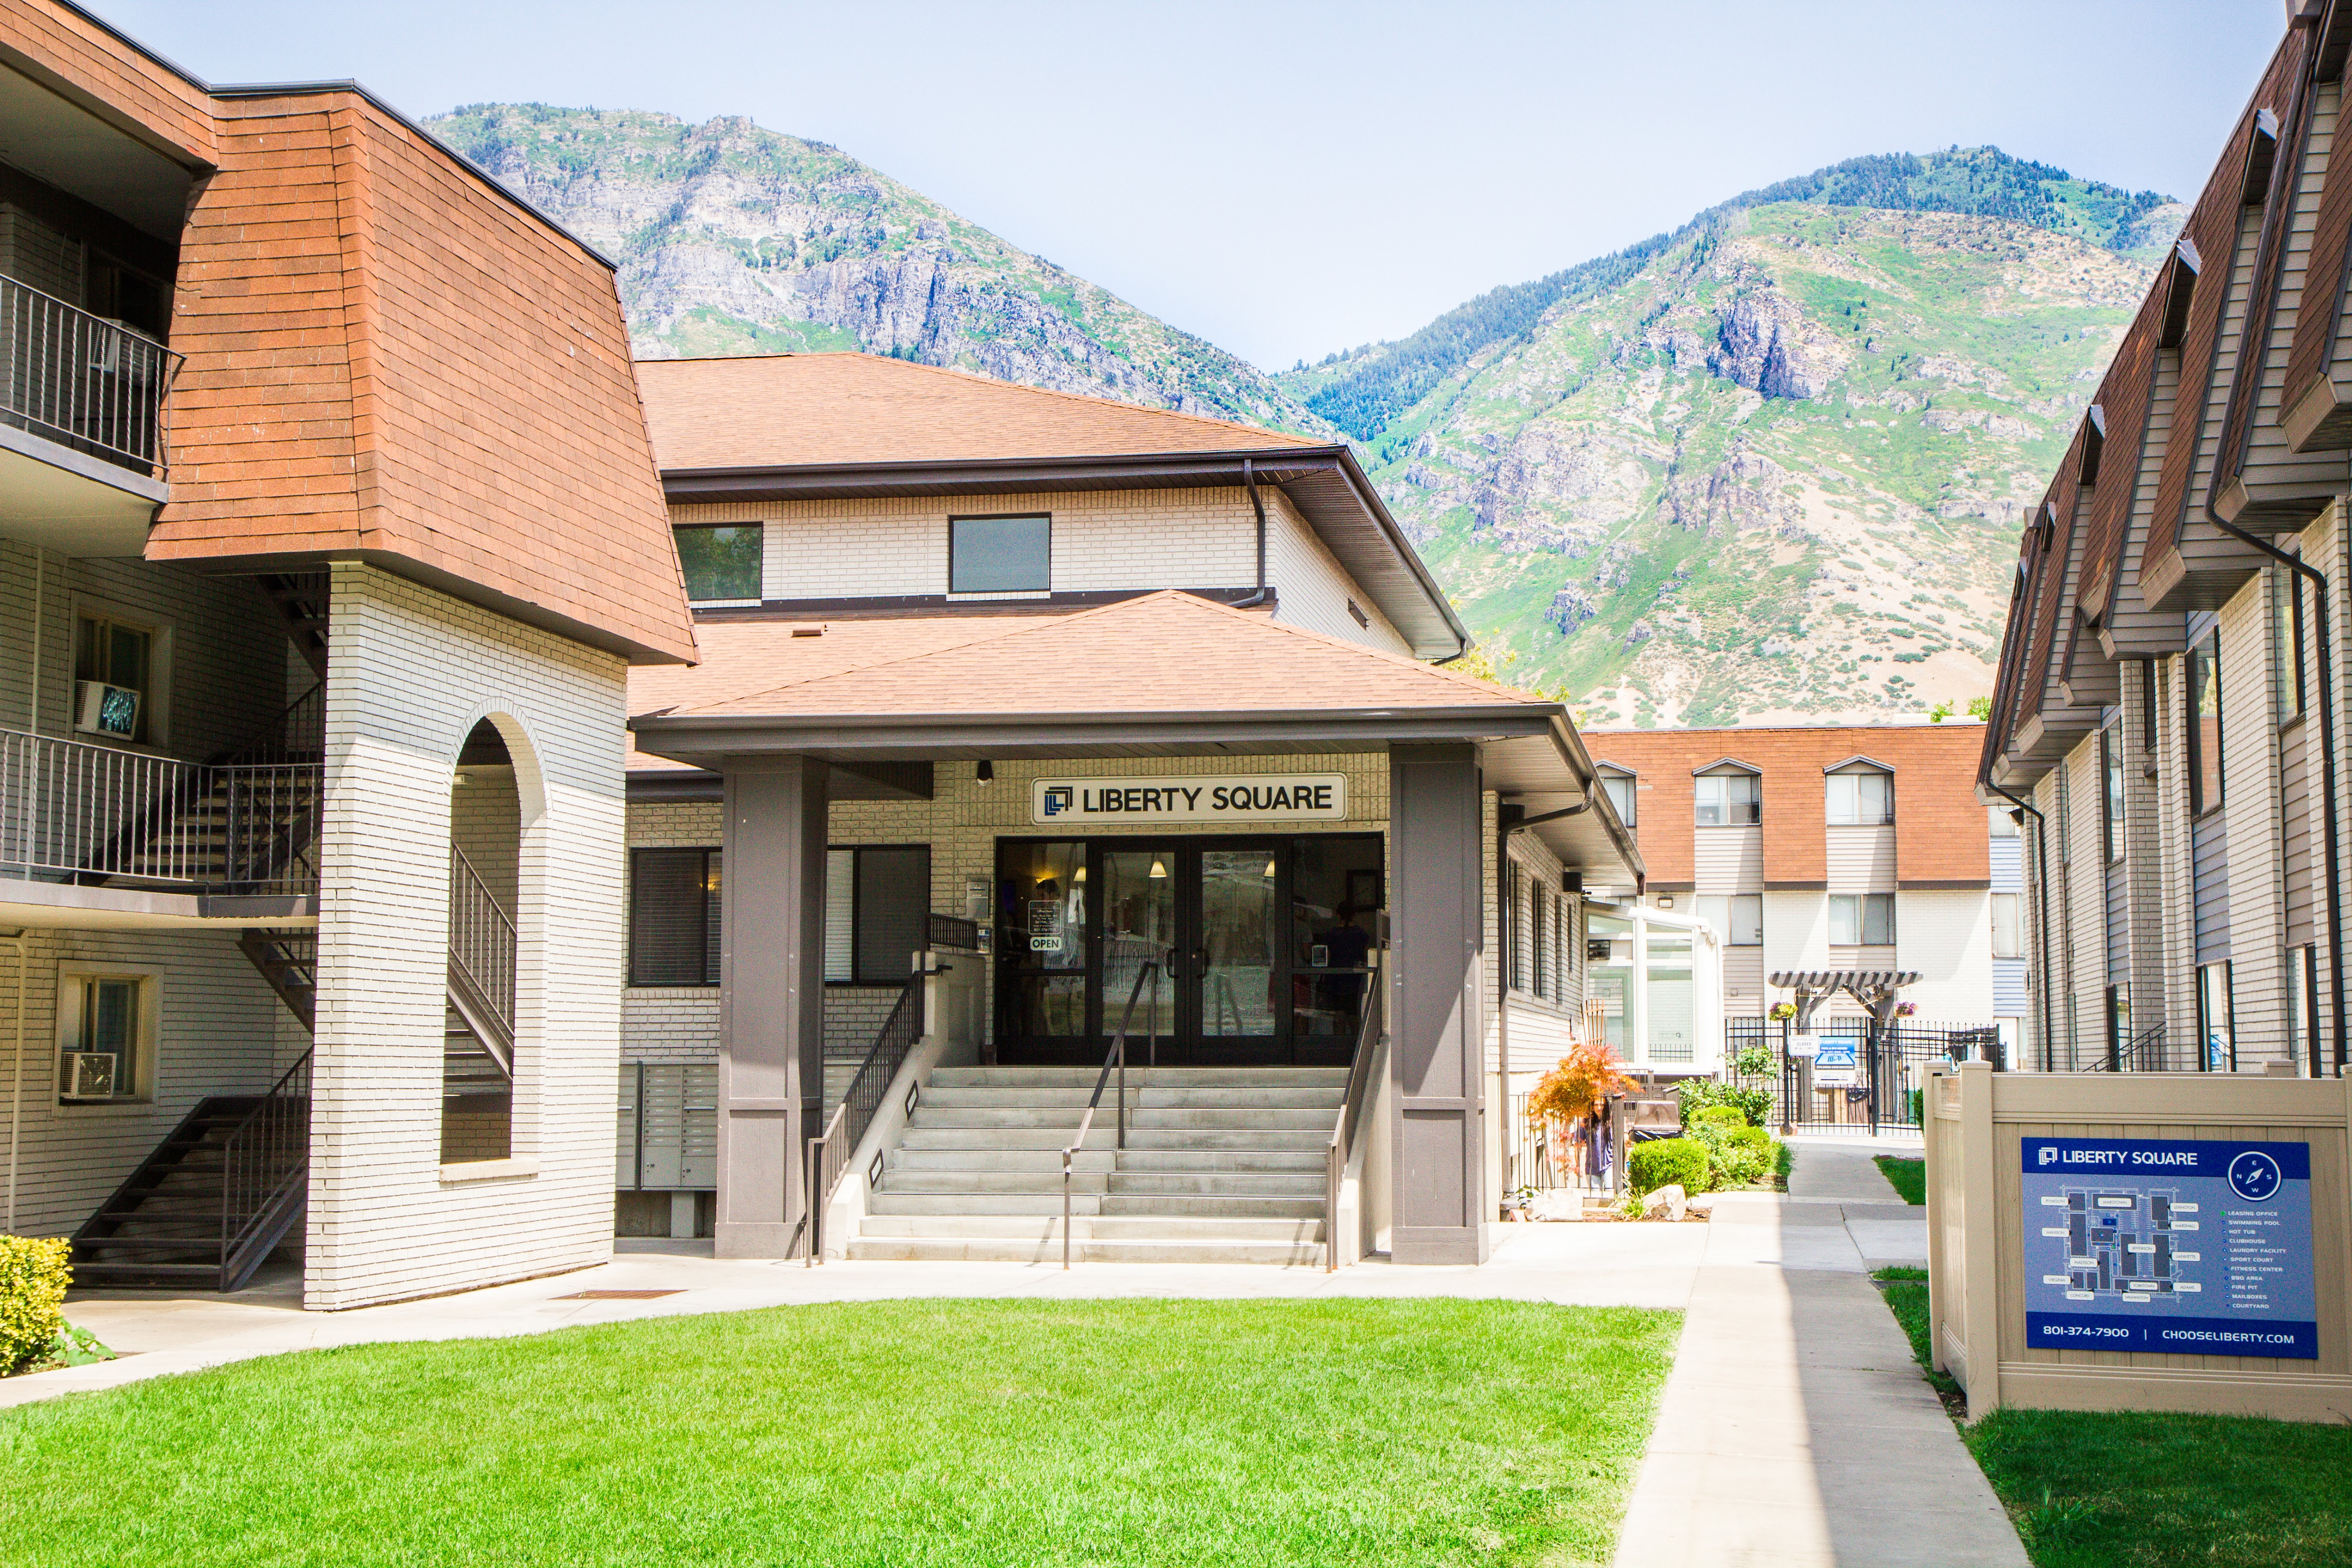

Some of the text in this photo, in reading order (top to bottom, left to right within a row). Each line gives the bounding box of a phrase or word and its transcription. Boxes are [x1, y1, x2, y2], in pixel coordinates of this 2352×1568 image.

[1083, 785, 1332, 812] LIBERTY SQUARE
[1033, 939, 1058, 948] OPEN
[2063, 1151, 2198, 1165] LIBERTY SQUARE
[2043, 1326, 2294, 1344] 801-374-7900 CHOOSELIBERTY.COM
